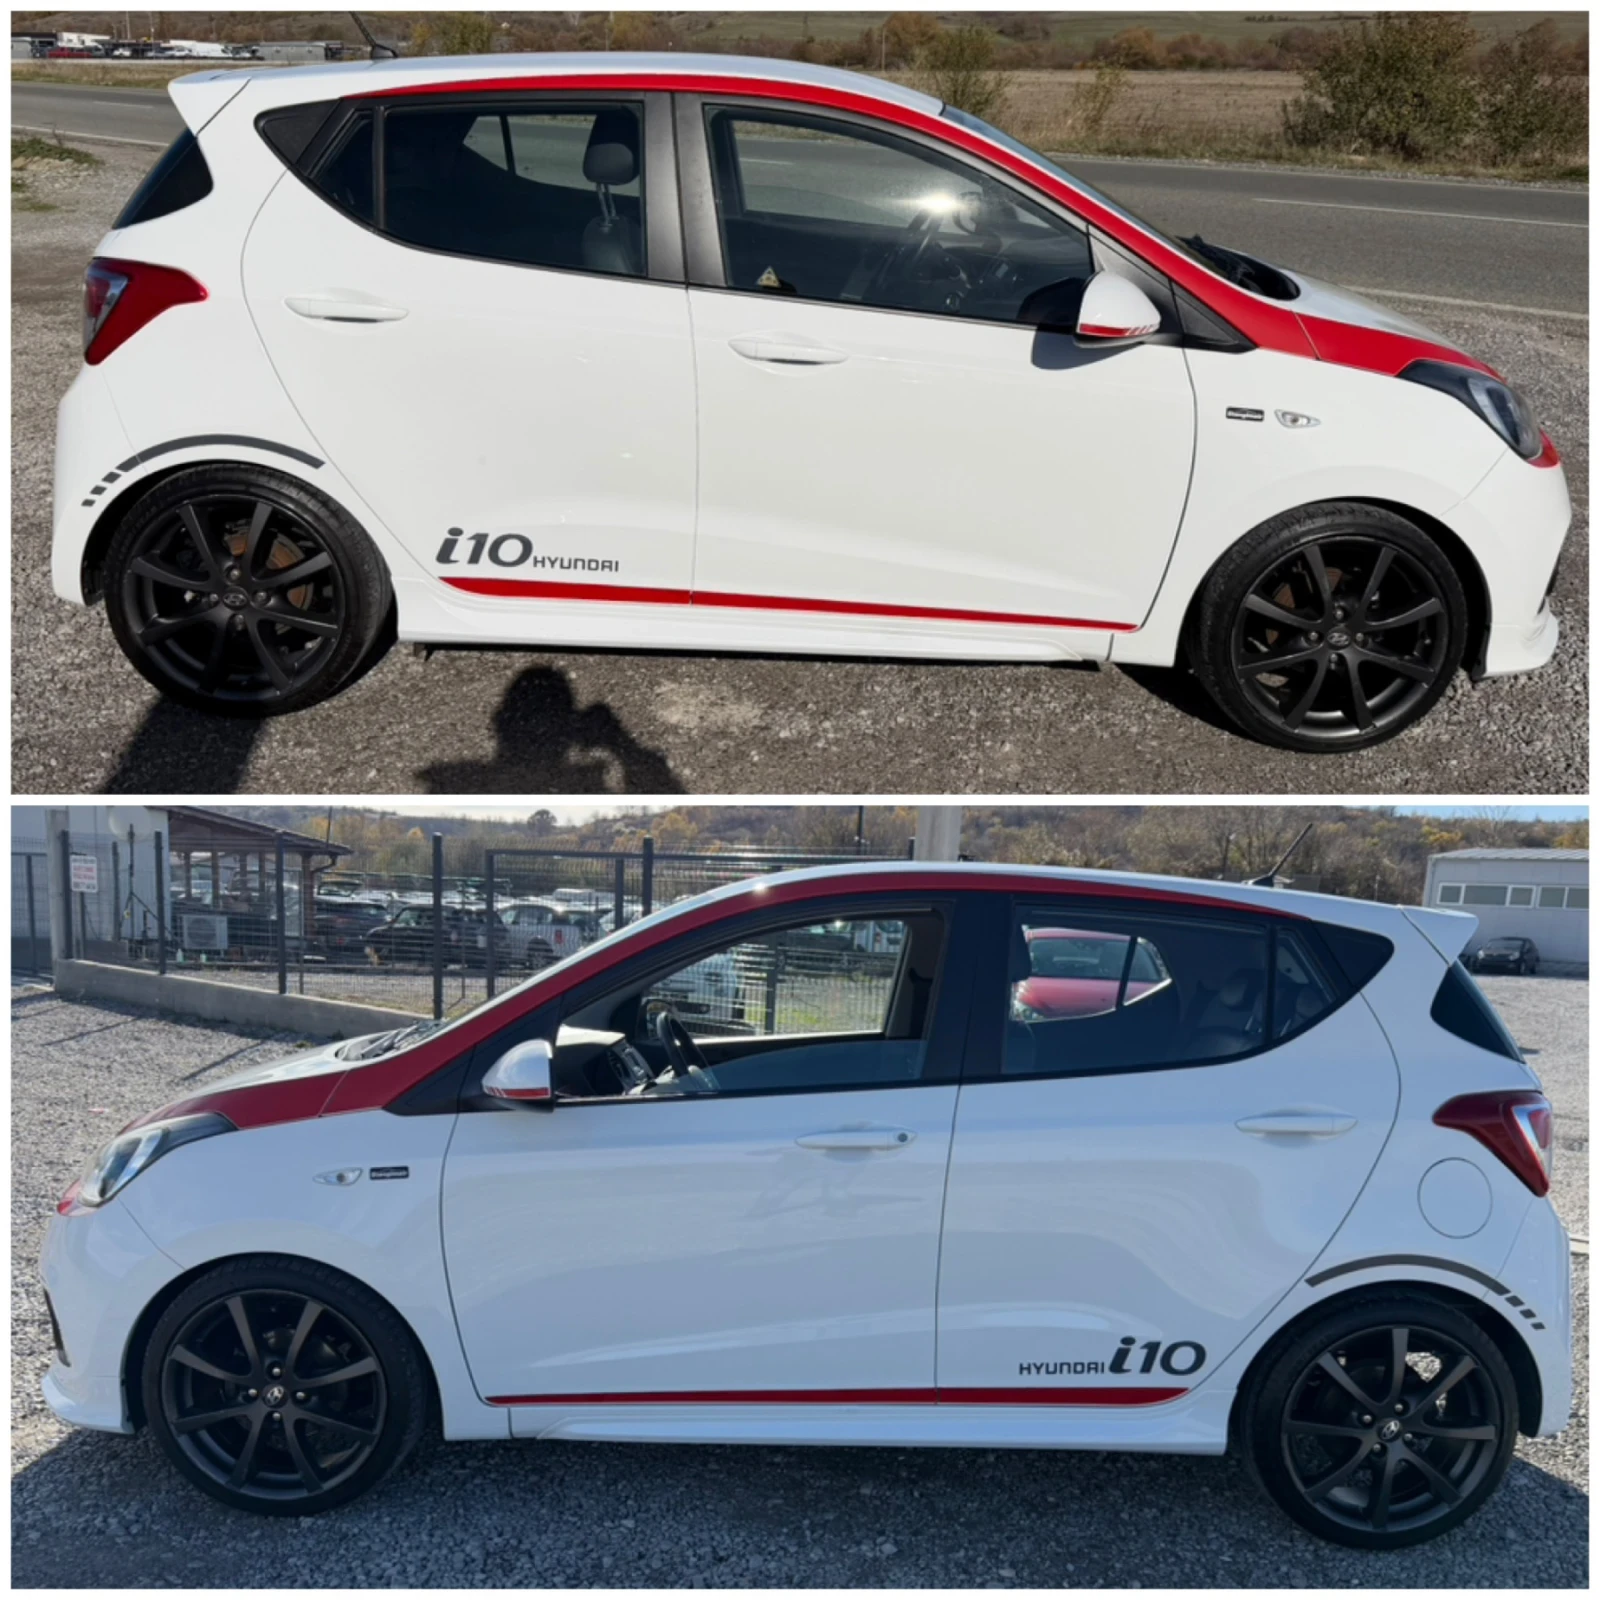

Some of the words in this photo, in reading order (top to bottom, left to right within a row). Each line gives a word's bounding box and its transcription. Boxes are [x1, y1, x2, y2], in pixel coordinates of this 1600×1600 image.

[435, 527, 533, 567] i10
[533, 555, 619, 572] HYUNDAI
[1019, 1361, 1105, 1375] HYUNDAI
[1108, 1336, 1206, 1376] i10
